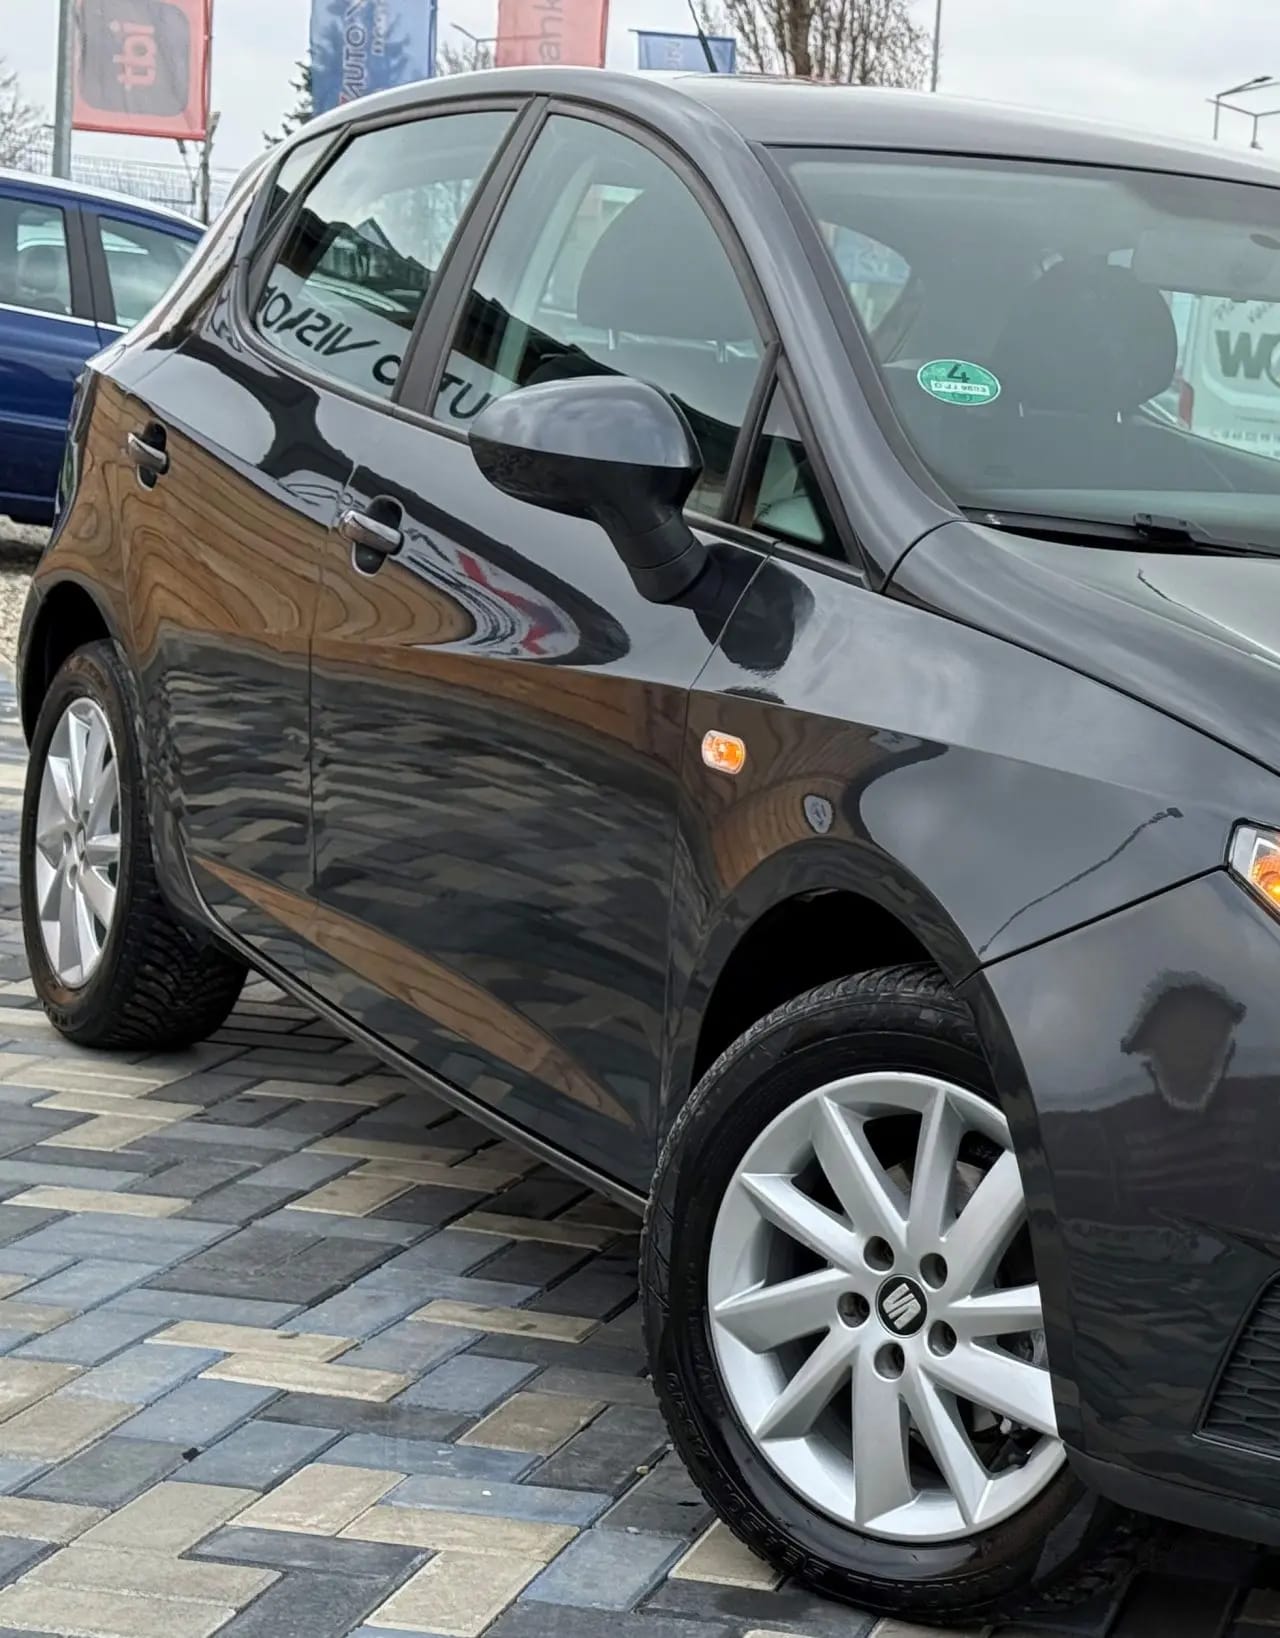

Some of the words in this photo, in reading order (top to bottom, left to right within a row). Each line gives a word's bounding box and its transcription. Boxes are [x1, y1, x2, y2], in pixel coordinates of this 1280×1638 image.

[110, 20, 157, 90] tbi
[342, 24, 368, 98] AUTO
[532, 0, 562, 65] ank
